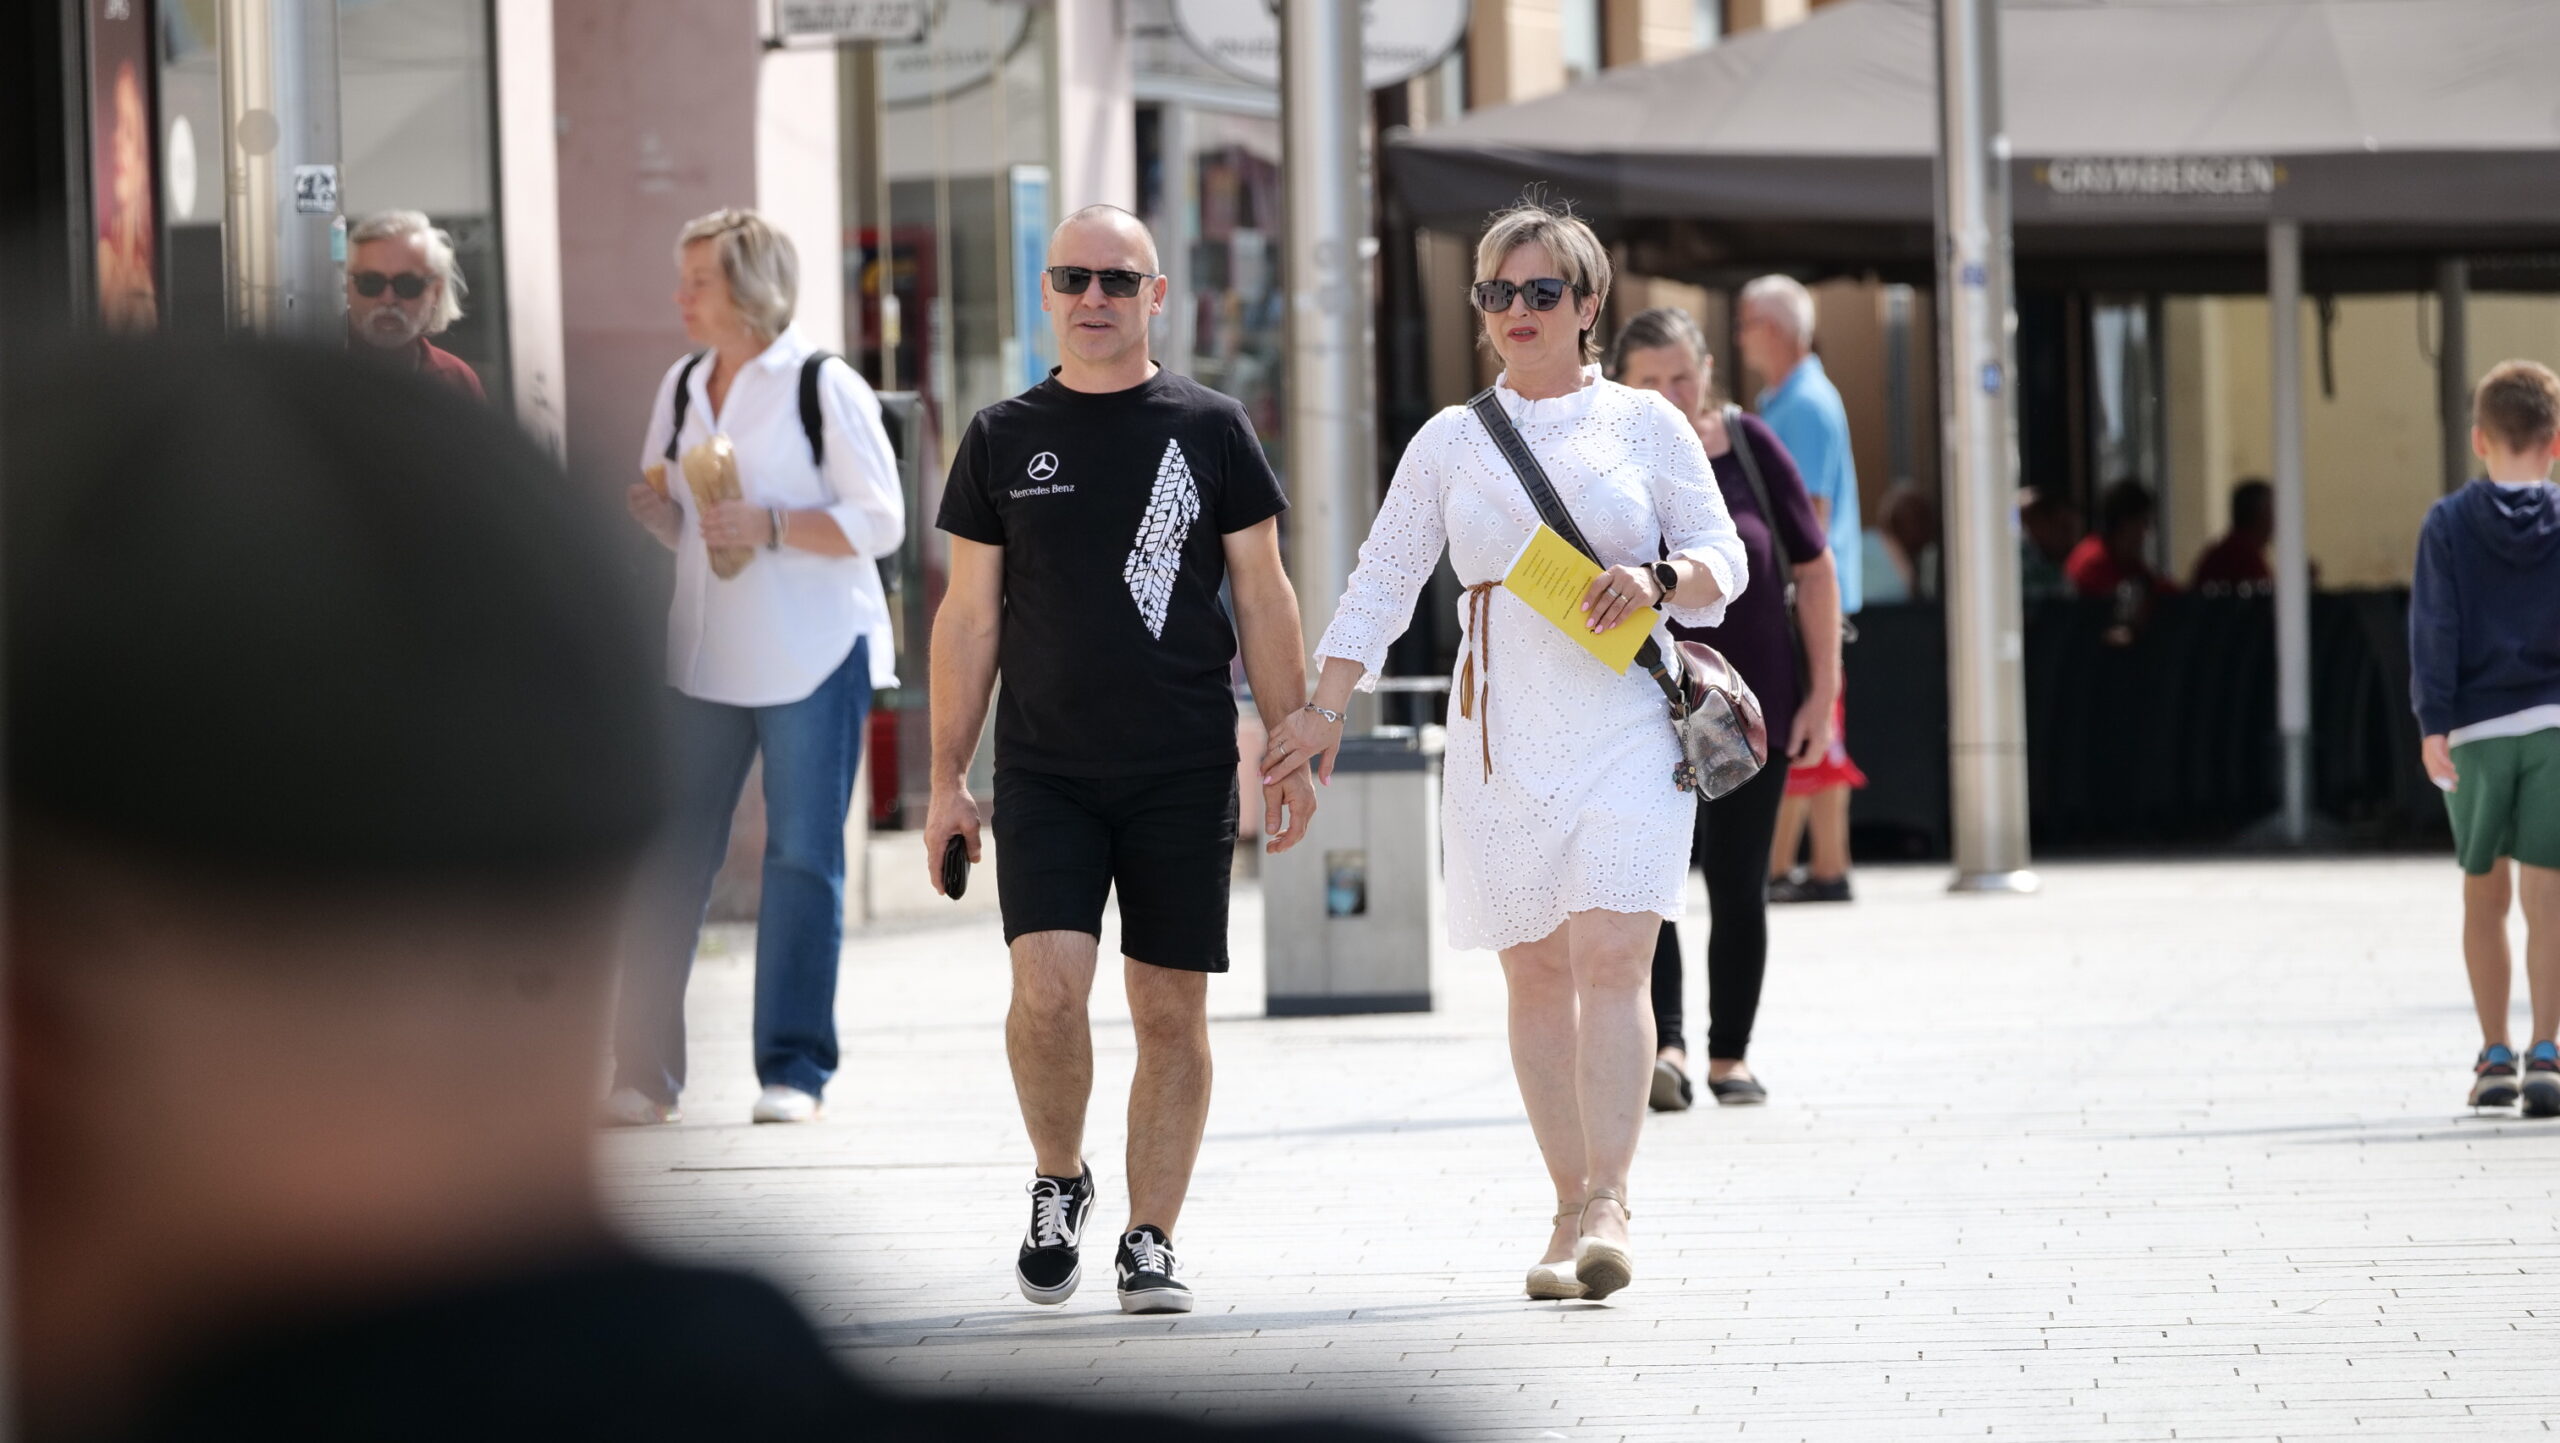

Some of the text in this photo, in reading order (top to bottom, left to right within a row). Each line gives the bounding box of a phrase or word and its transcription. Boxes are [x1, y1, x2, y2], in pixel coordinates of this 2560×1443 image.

[1009, 484, 1075, 499] Mercedes Benz
[1491, 419, 1538, 479] CHANGE
[1530, 478, 1559, 519] THE
